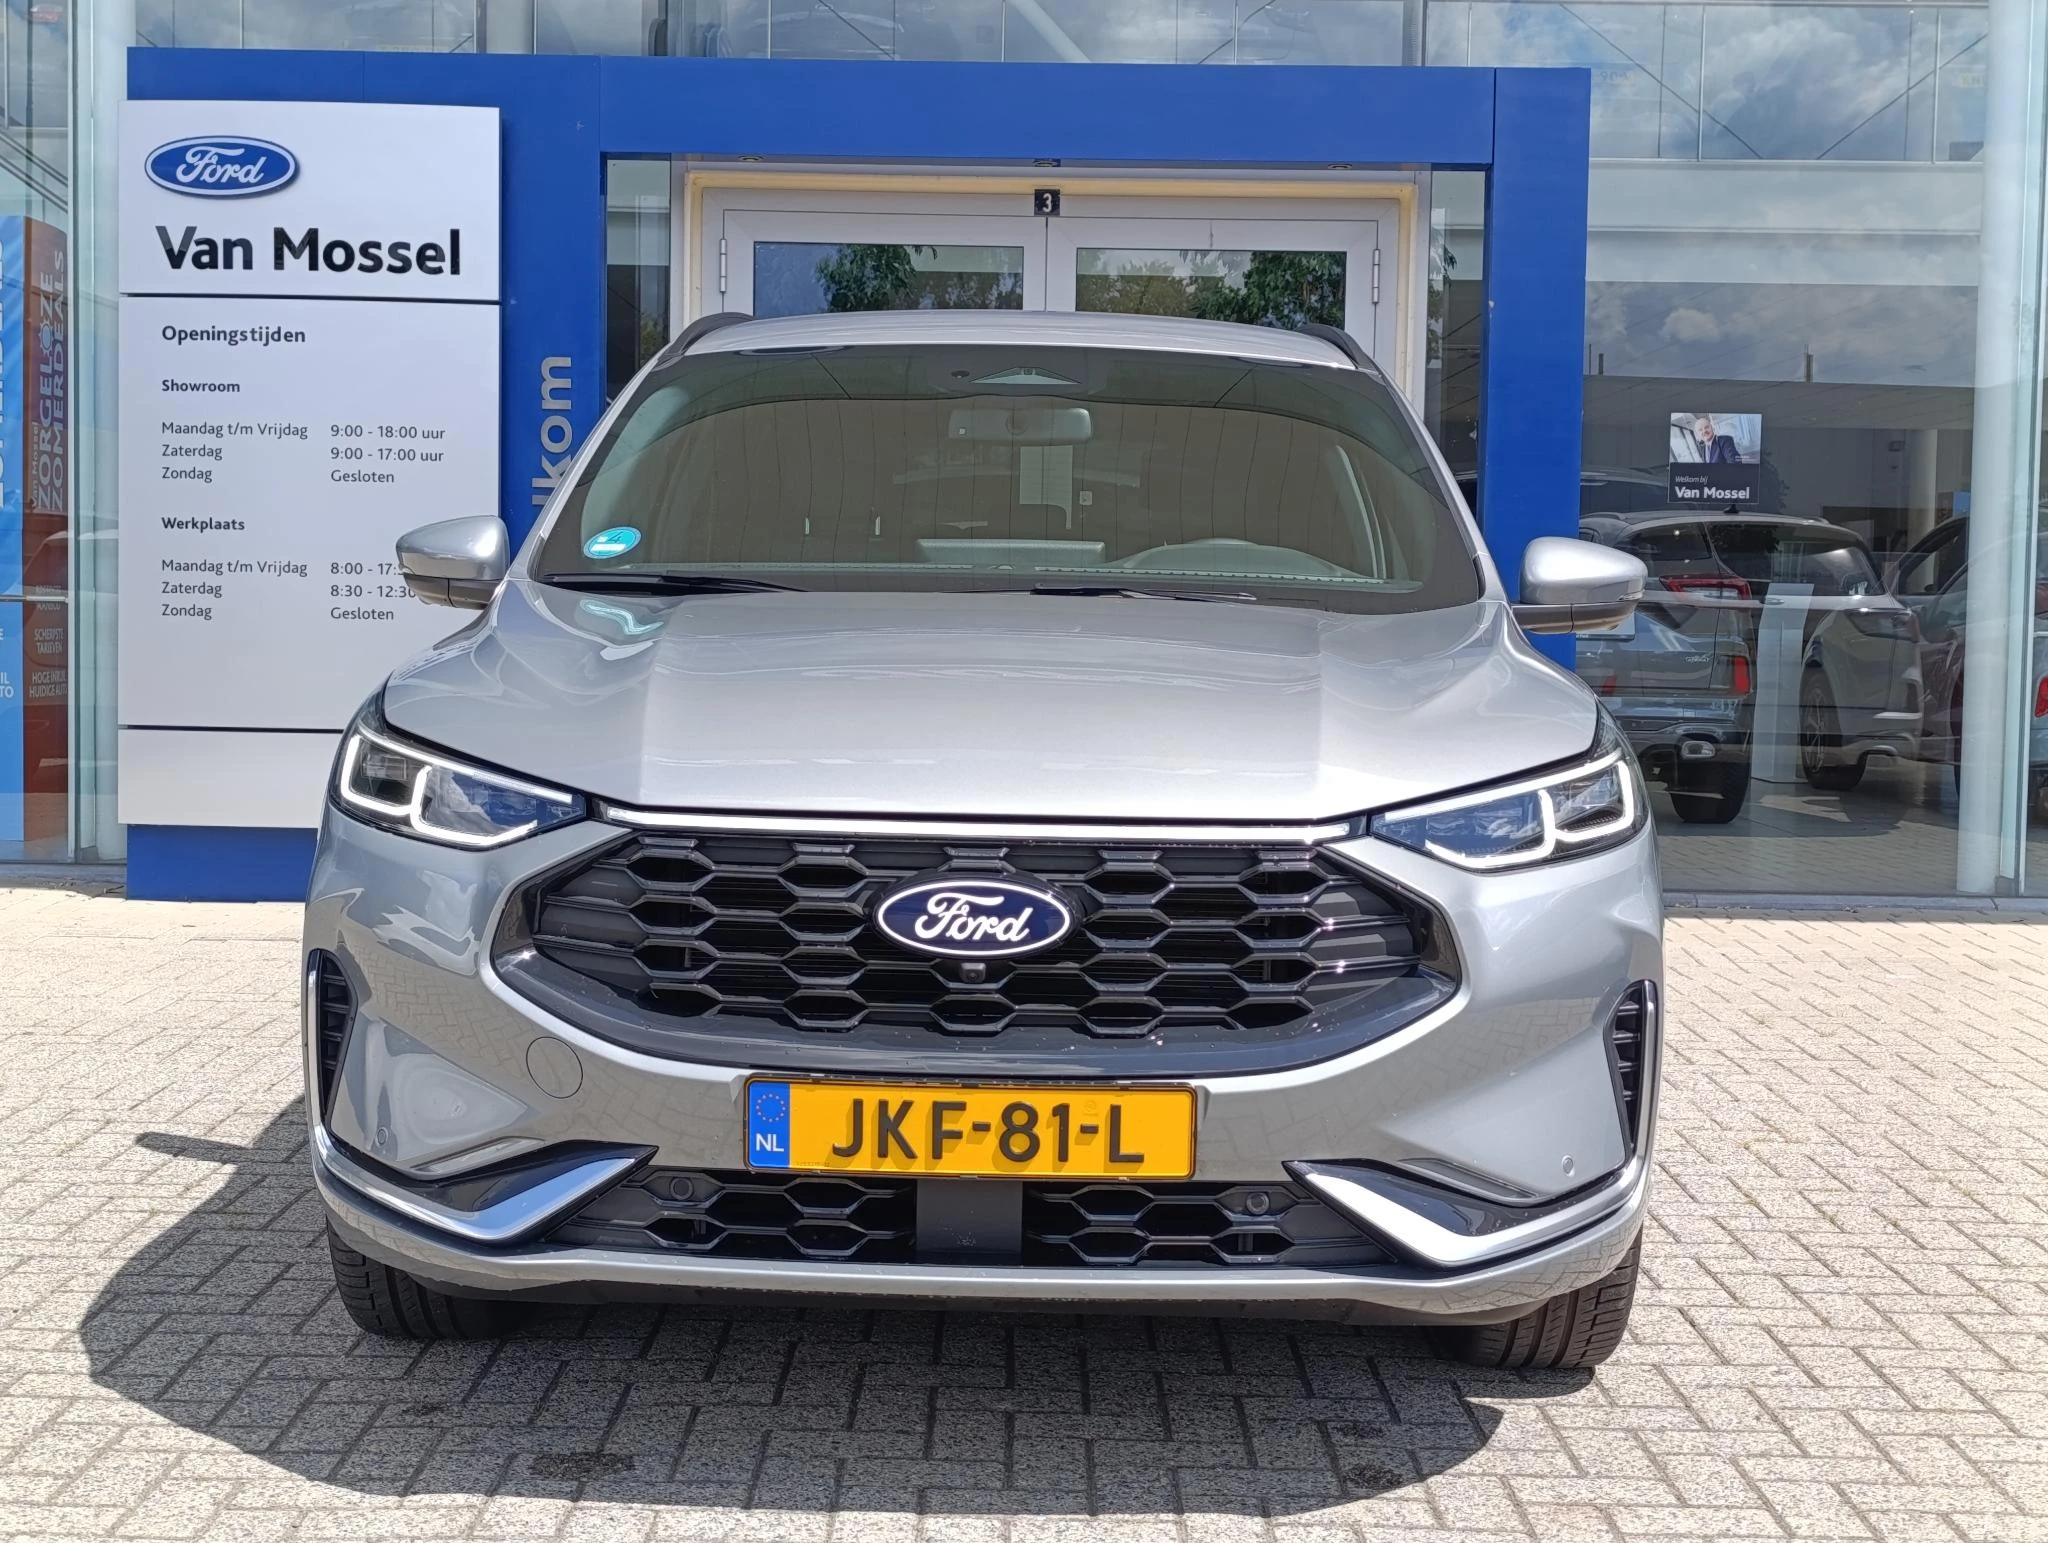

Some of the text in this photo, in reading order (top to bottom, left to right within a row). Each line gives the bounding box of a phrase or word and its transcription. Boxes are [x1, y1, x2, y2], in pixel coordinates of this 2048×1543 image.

[175, 145, 267, 184] Ford
[1042, 193, 1052, 212] 3
[155, 225, 461, 276] Van Mossel
[161, 325, 306, 347] Openingstijden
[52, 249, 64, 513] ZOMERDEALS
[161, 378, 241, 393] Showroom
[161, 421, 308, 440] Maandag t/m Vrijdag
[330, 424, 363, 438] 9:00
[377, 425, 418, 439] 18:00
[422, 429, 446, 440] uur
[31, 421, 40, 475] Mossel
[161, 443, 223, 461] Zaterdag
[330, 446, 363, 460] 9:00
[377, 447, 416, 462] 17:00
[420, 452, 445, 462] uur
[161, 466, 213, 483] Zondag
[330, 469, 395, 483] Gesloten
[1674, 486, 1750, 499] Van Mossel
[161, 516, 245, 533] Werkplaats
[161, 559, 308, 578] Maandag t/m Vrijdag
[330, 562, 364, 575] 8:00
[161, 581, 223, 599] Zaterdag
[330, 584, 363, 598] 8:30
[161, 603, 213, 621] Zondag
[330, 606, 394, 621] Gesloten
[914, 892, 1034, 942] Ford
[831, 1097, 1145, 1164] JKF-81-L
[755, 1133, 785, 1153] NL
